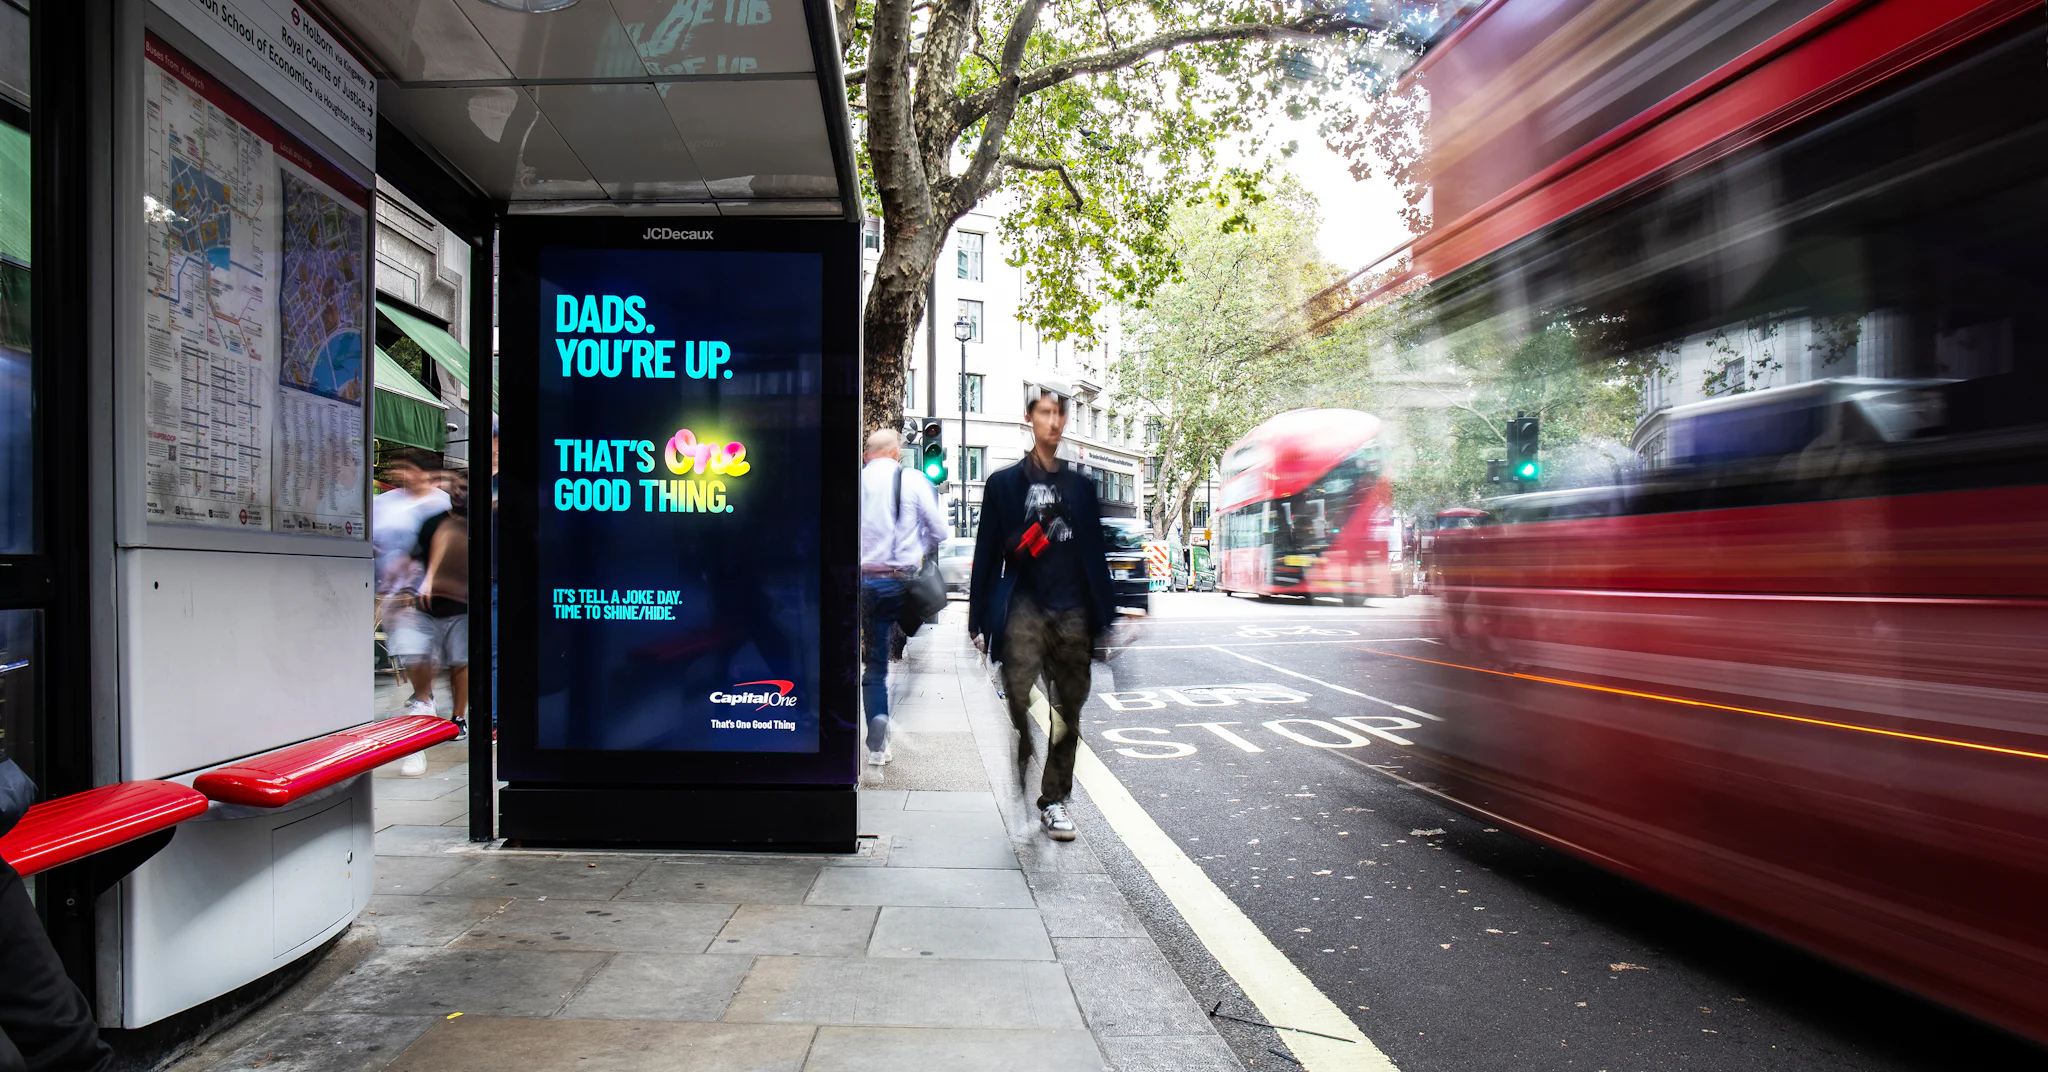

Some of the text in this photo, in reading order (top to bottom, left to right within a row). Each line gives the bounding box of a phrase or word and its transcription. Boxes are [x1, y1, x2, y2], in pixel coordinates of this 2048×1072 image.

[145, 41, 205, 90] Buses from Aldwych
[221, 5, 254, 45] School
[257, 39, 267, 54] of
[269, 44, 313, 93] Economics
[314, 89, 323, 101] via
[324, 93, 350, 122] Houghton
[350, 117, 367, 137] Street
[281, 26, 366, 112] Royal Courts of Justice
[303, 17, 334, 58] Holborn
[335, 53, 343, 66] via
[343, 58, 367, 89] Kingsway
[642, 227, 714, 240] JCDecaux
[555, 294, 656, 334] DADS.
[555, 338, 734, 380] YOU'RE UP.
[554, 428, 751, 477] THAT'S One
[554, 478, 734, 514] GOOD THING.
[553, 589, 683, 606] IT'S TELL A JOKE DAY.
[553, 604, 676, 621] TIME TO SHINE/HIDE.
[711, 719, 796, 732] That's One Good Thing
[1101, 715, 1423, 760] STOP
